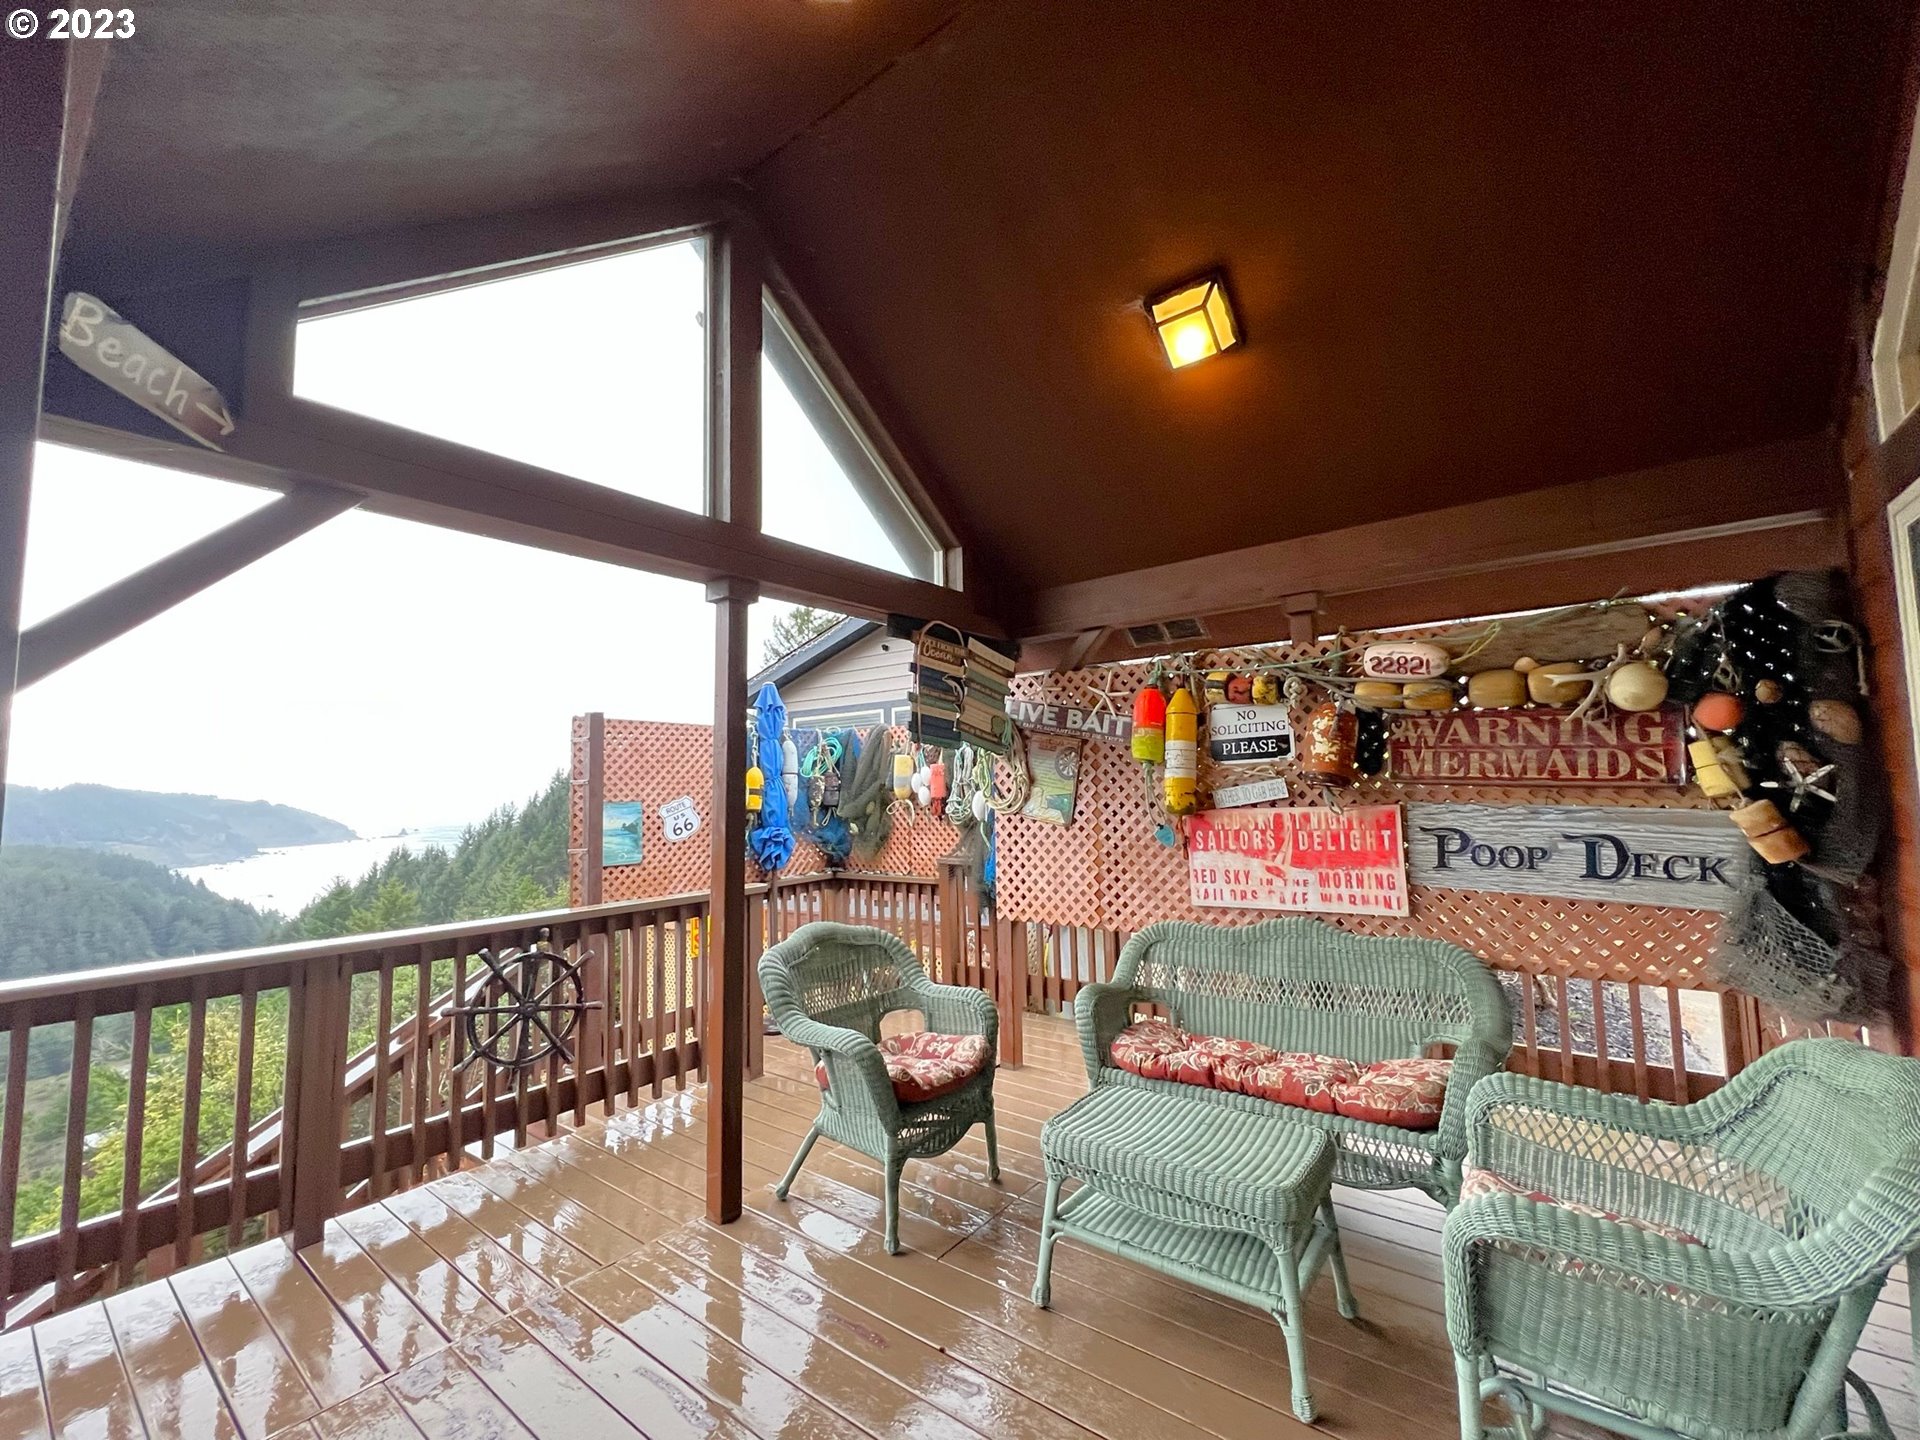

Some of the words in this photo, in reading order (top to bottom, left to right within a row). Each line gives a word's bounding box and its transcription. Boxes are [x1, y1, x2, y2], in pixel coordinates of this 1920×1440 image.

[60, 297, 189, 415] Beach
[1369, 655, 1431, 675] 22821
[1004, 700, 1060, 726] LIVE
[1066, 708, 1132, 736] BAIT
[1236, 709, 1257, 721] NO
[1211, 720, 1286, 736] SOLICITING
[1401, 712, 1665, 747] WARNING
[1222, 739, 1278, 755] PLEASE
[1401, 746, 1667, 780] MERMAIDS
[1241, 786, 1252, 801] TO
[665, 801, 687, 814] ROUTE
[673, 818, 693, 836] 66
[1195, 829, 1275, 850] SAILORS
[1298, 829, 1392, 852] DELIGHT
[1193, 868, 1217, 884] RED
[1224, 868, 1251, 885] SKY
[1259, 877, 1274, 887] IN
[1283, 878, 1309, 888] THE
[1318, 871, 1396, 891] MORNING
